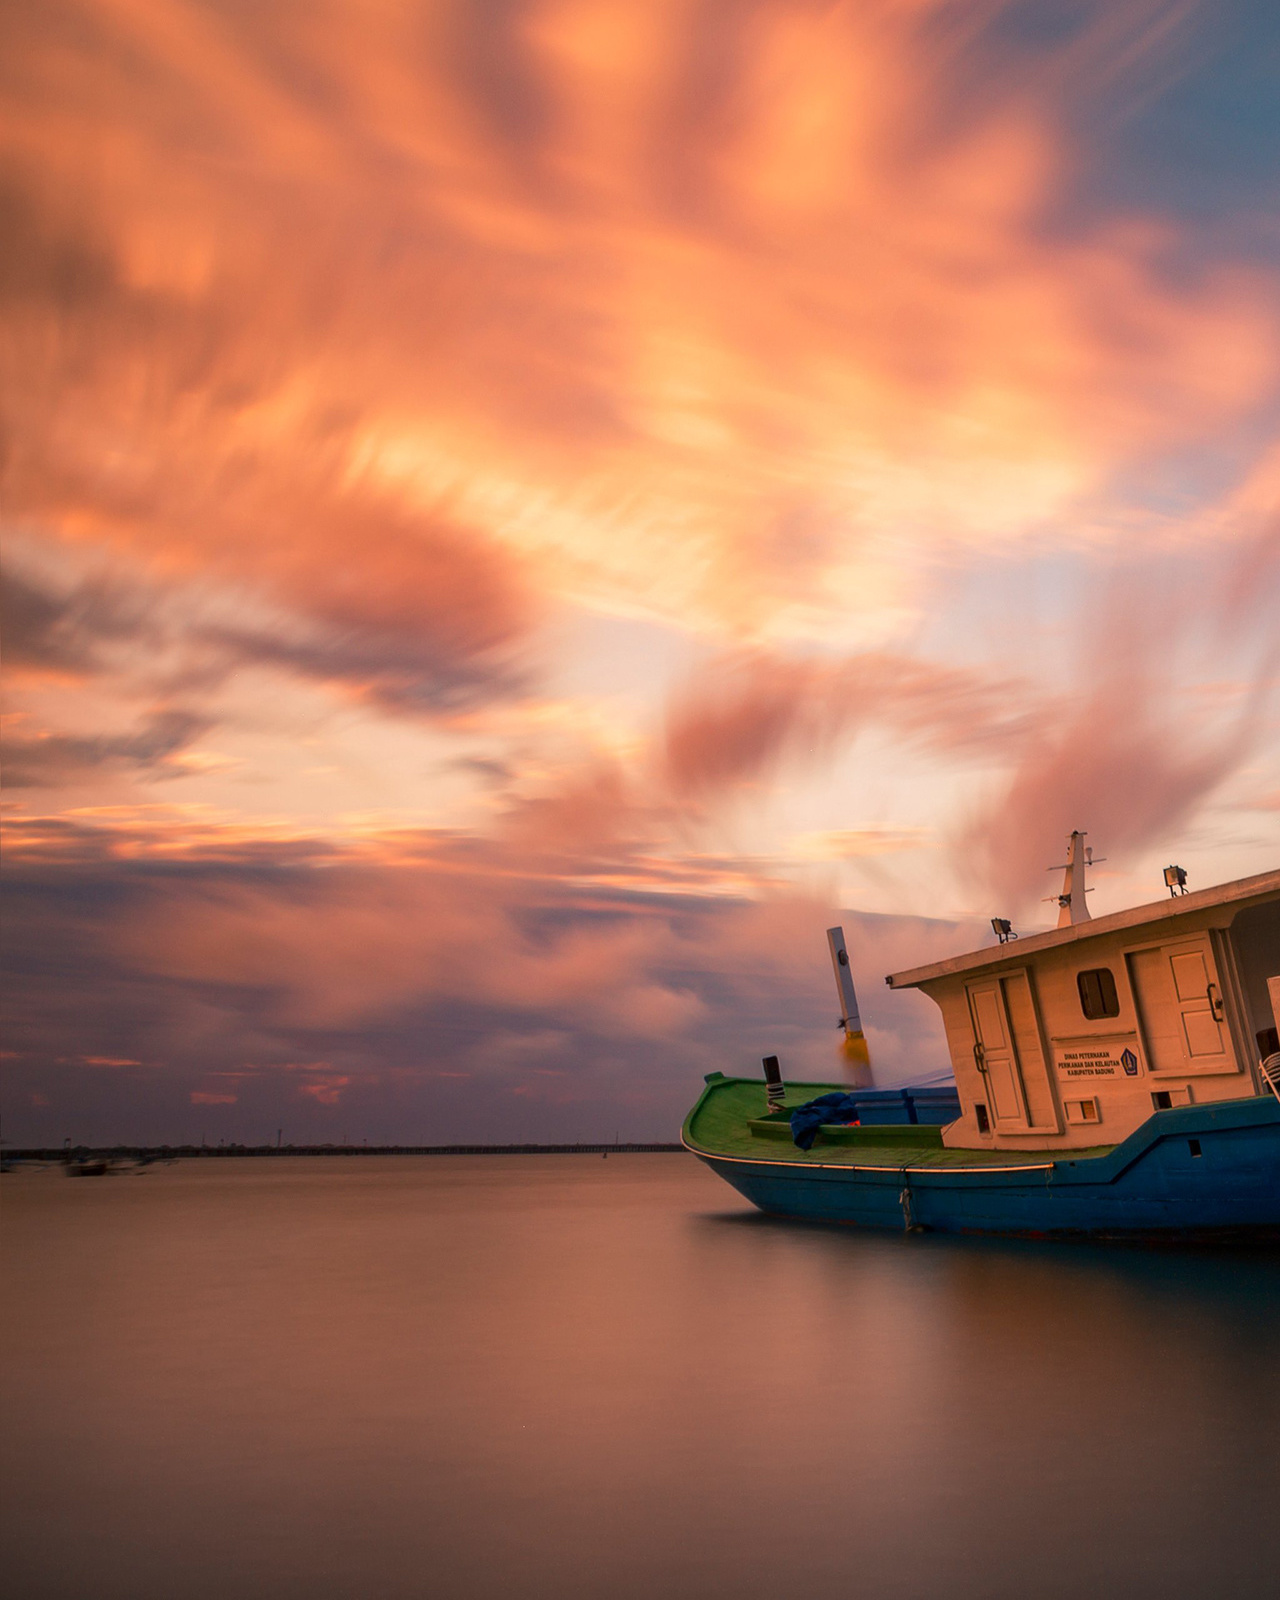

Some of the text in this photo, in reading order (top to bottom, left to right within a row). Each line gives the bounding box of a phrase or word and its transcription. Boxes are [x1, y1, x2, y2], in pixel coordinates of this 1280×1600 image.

[1084, 1060, 1094, 1068] DAN
[1095, 1060, 1120, 1068] KELAUTAN
[1095, 1067, 1115, 1075] BADUNG
